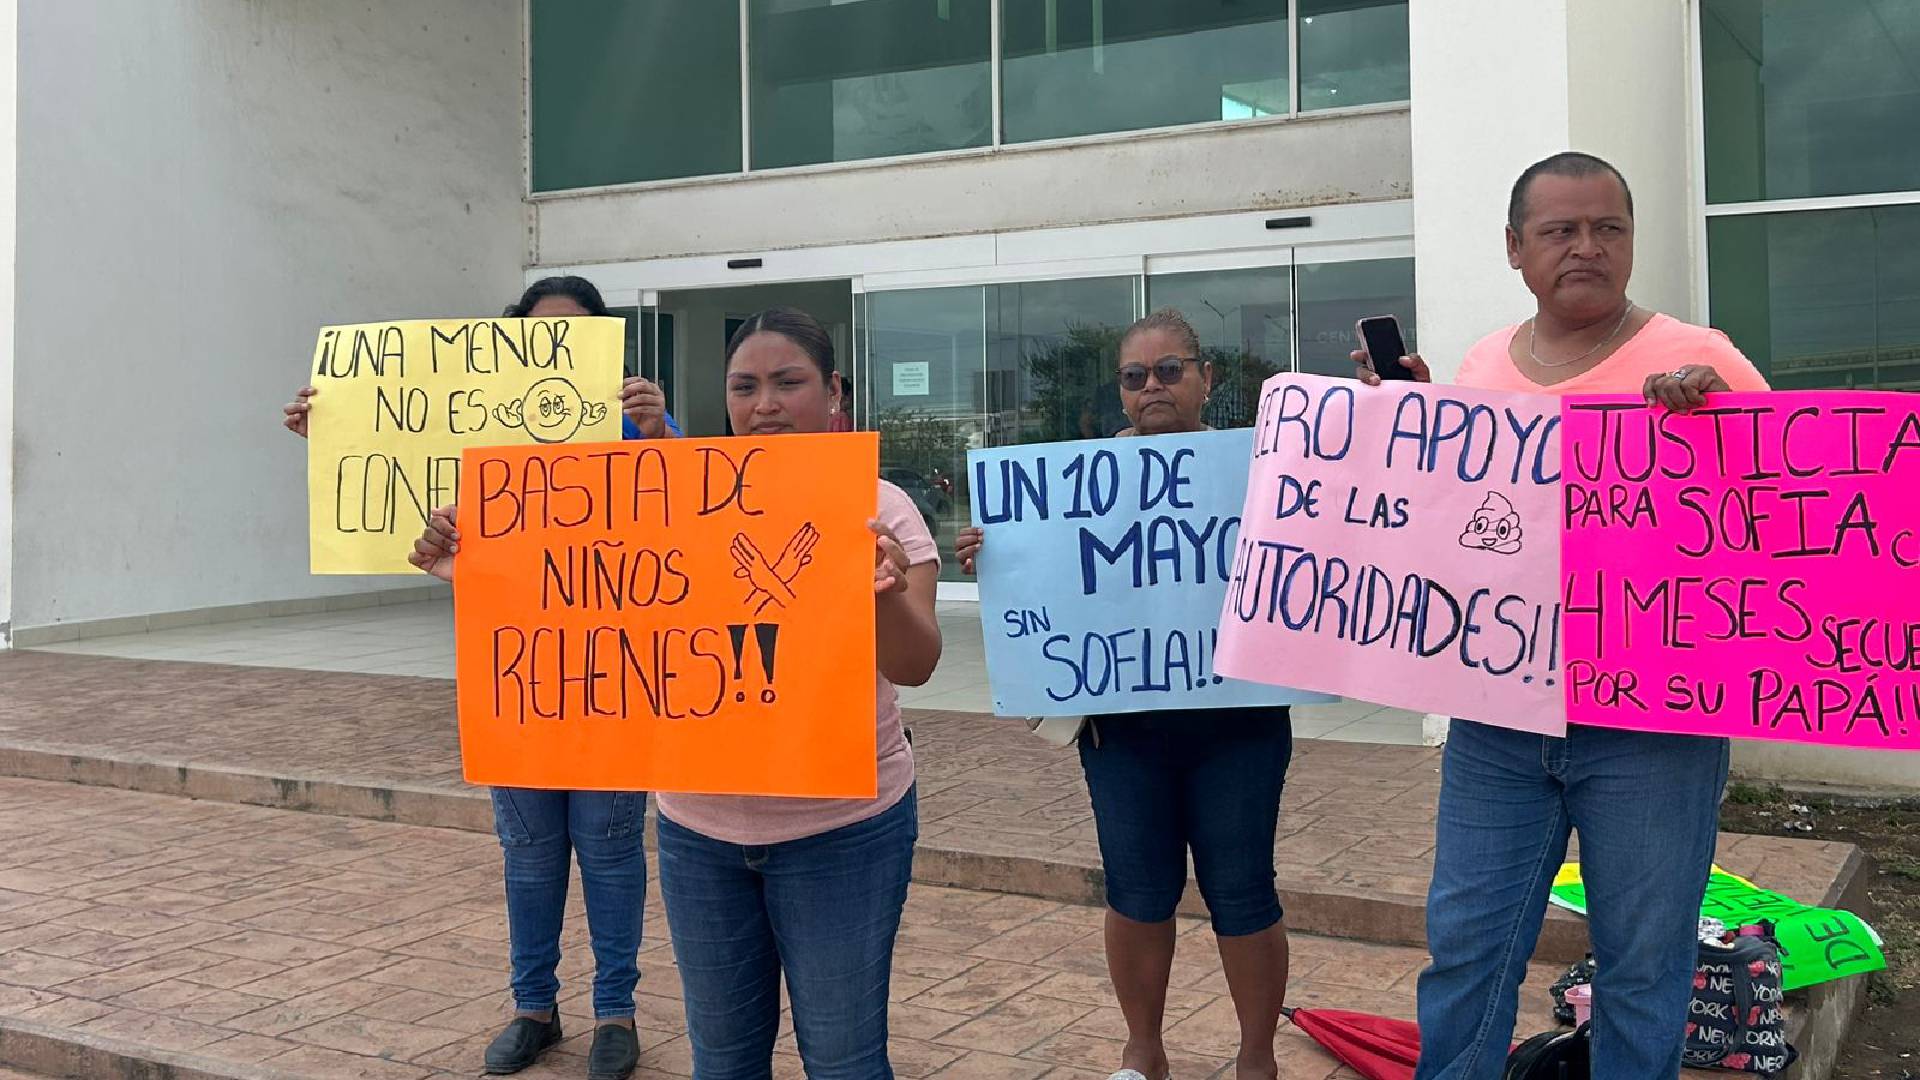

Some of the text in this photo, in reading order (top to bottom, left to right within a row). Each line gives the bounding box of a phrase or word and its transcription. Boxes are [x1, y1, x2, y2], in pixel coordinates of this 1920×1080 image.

[317, 319, 574, 378] ¡UNA MENOR
[376, 386, 488, 434] NO ES
[1386, 391, 1561, 484] APOYO
[1570, 403, 1920, 482] JUSTICIA
[479, 448, 766, 538] BASTA DE
[976, 448, 1195, 525] UN 10 DE
[1276, 474, 1409, 528] DE LAS
[1565, 484, 1658, 530] PARA
[1676, 486, 1880, 558] SOFIA
[543, 540, 690, 611] NIÑOS
[1079, 515, 1241, 595] MAYO
[1004, 606, 1051, 638] SIN
[1227, 538, 1561, 686] AUTORIDADES!!
[1565, 570, 1920, 673] 4 MESES SECUE
[494, 623, 780, 725] REHENES!!
[1567, 660, 1648, 711] POR
[1664, 675, 1724, 715] SU
[1806, 913, 1871, 971] DE
[1690, 996, 1728, 1020] ORK
